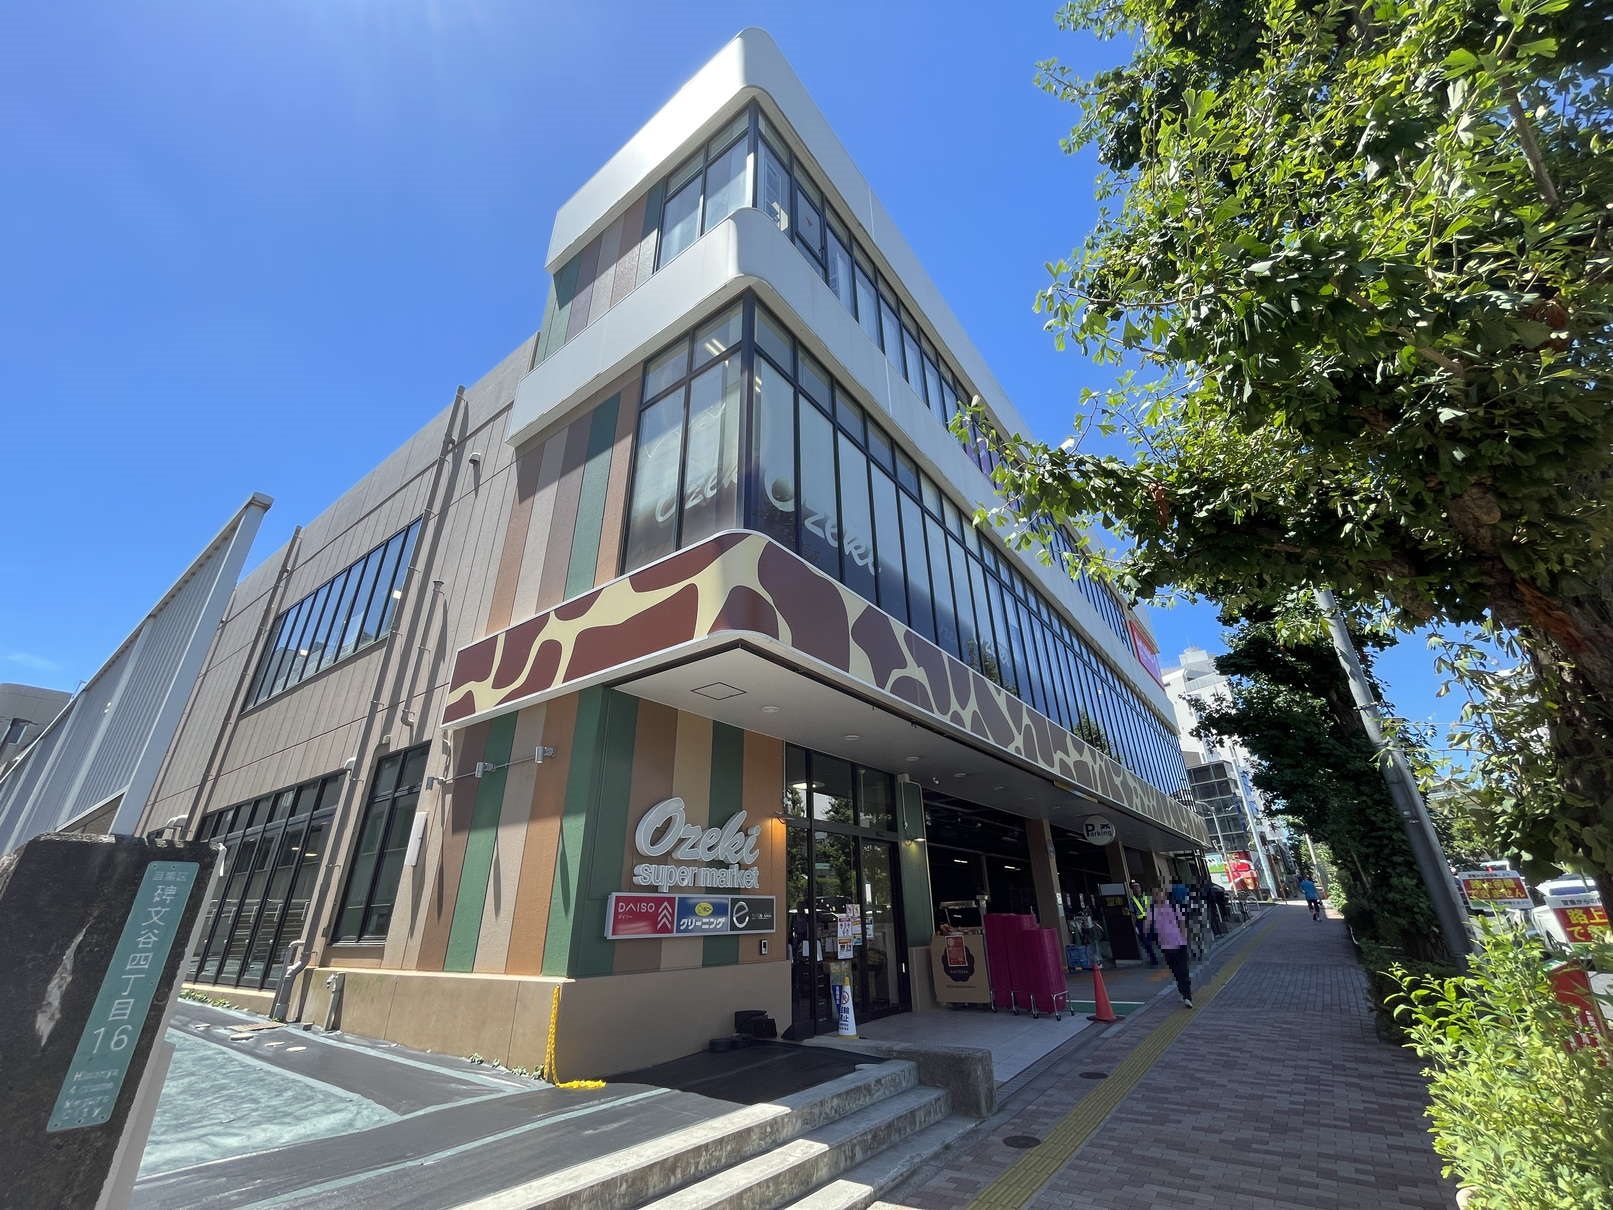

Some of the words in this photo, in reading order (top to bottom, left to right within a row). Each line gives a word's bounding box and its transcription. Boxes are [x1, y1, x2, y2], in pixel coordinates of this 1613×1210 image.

[635, 797, 761, 865] Ozeki
[1085, 823, 1112, 838] Parking
[633, 863, 698, 893] super
[699, 863, 760, 889] market
[617, 902, 656, 913] DAISO
[1567, 909, 1609, 924] 路上
[679, 917, 727, 930] クリーニング
[107, 884, 178, 1023] 碑文谷四丁目
[92, 1024, 133, 1054] 16
